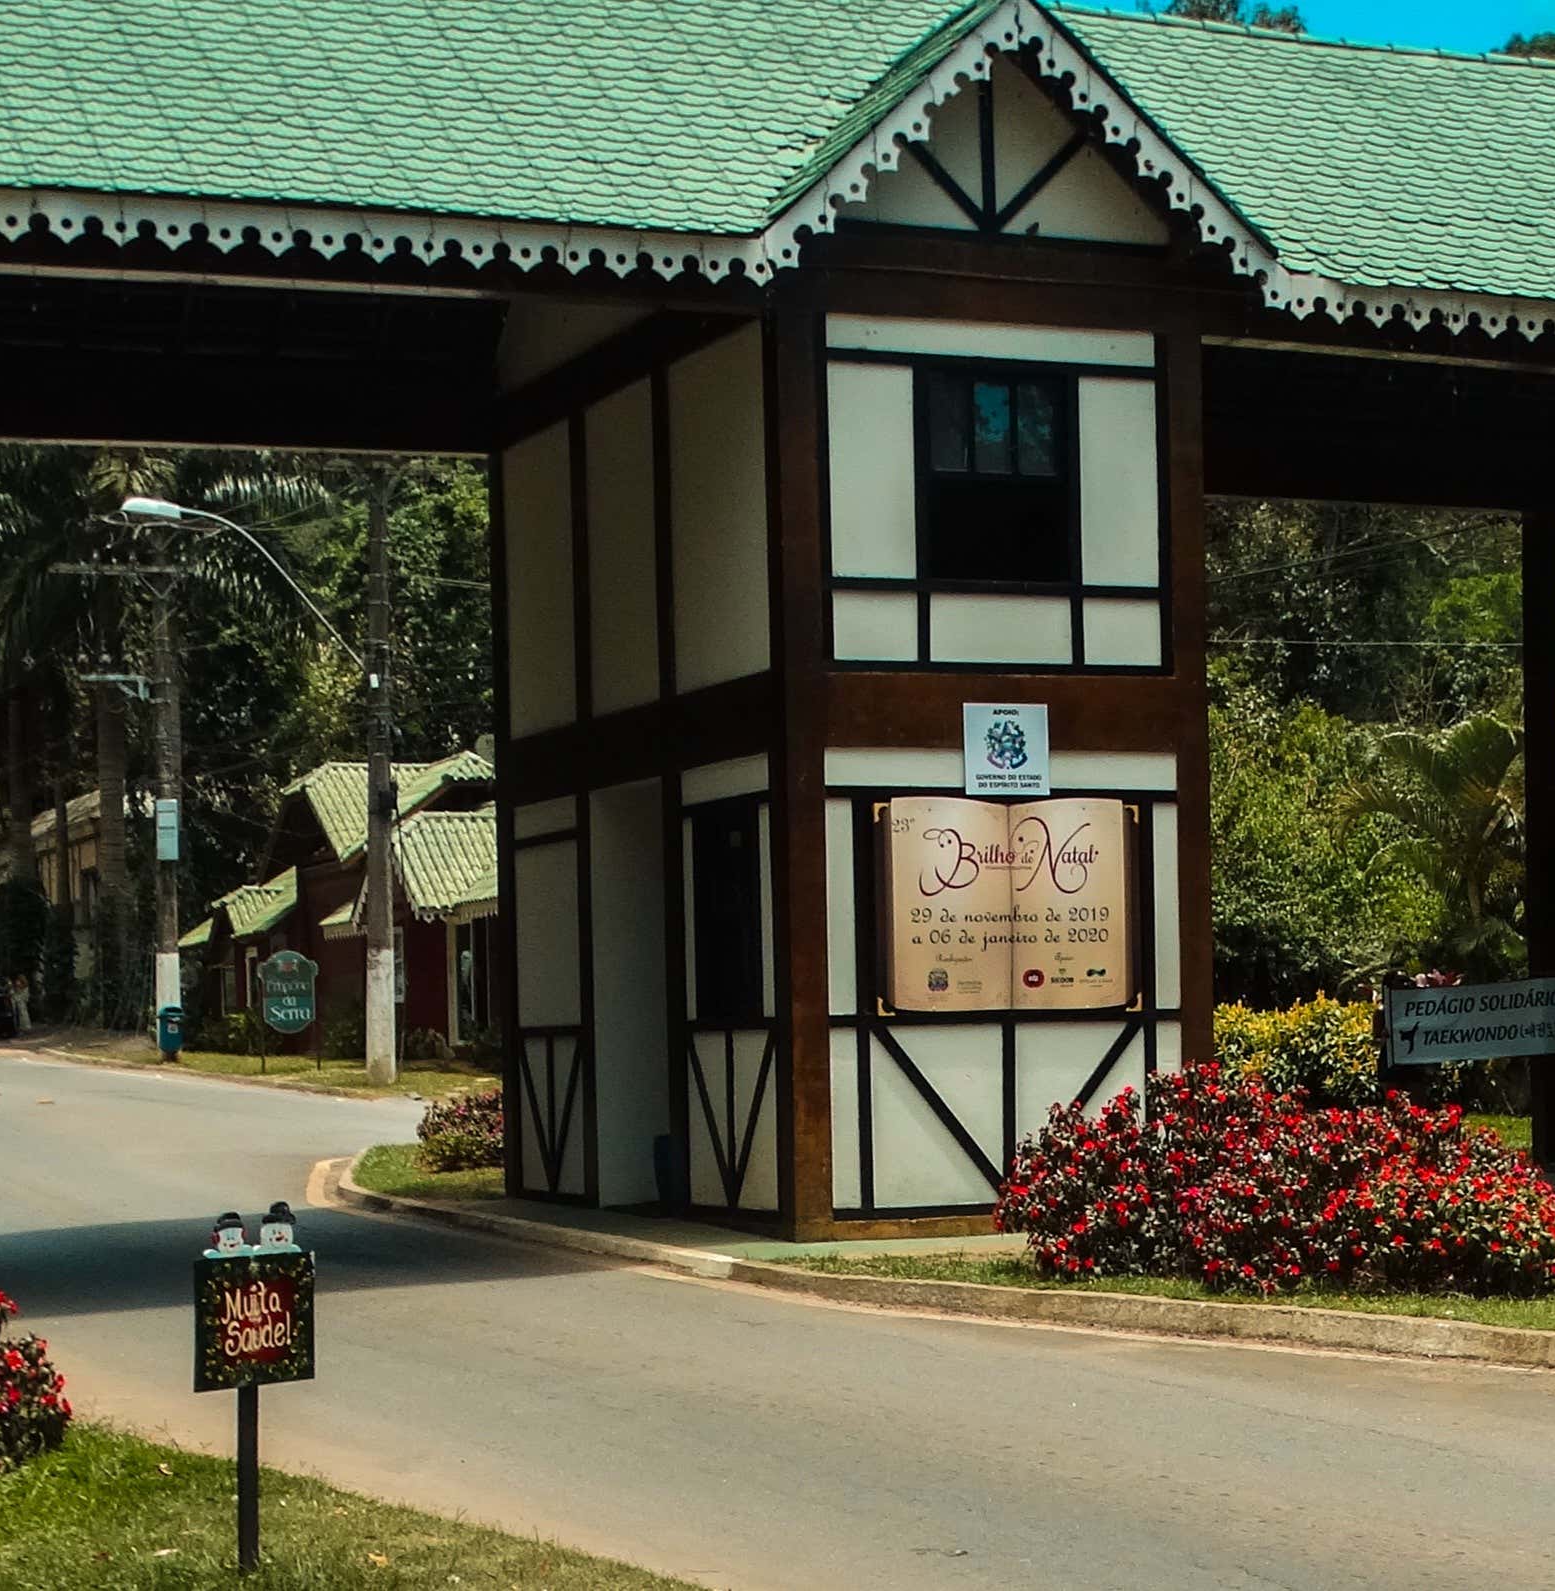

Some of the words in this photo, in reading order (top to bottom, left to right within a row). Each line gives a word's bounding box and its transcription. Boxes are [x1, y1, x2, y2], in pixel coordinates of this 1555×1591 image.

[919, 828, 1015, 896] Brilho
[1011, 816, 1099, 894] Natal
[910, 907, 932, 923] 29
[940, 907, 957, 923] de
[964, 903, 1039, 923] novembro
[1045, 906, 1061, 922] de
[1068, 906, 1110, 922] 2019
[911, 934, 922, 945] a
[929, 929, 951, 945] 06
[958, 929, 976, 944] de
[981, 930, 1038, 952] janeiro
[1044, 928, 1061, 943] de
[1067, 927, 1110, 943] 2020
[1405, 995, 1475, 1017] PEDÁGIO
[221, 1281, 283, 1324] Muita
